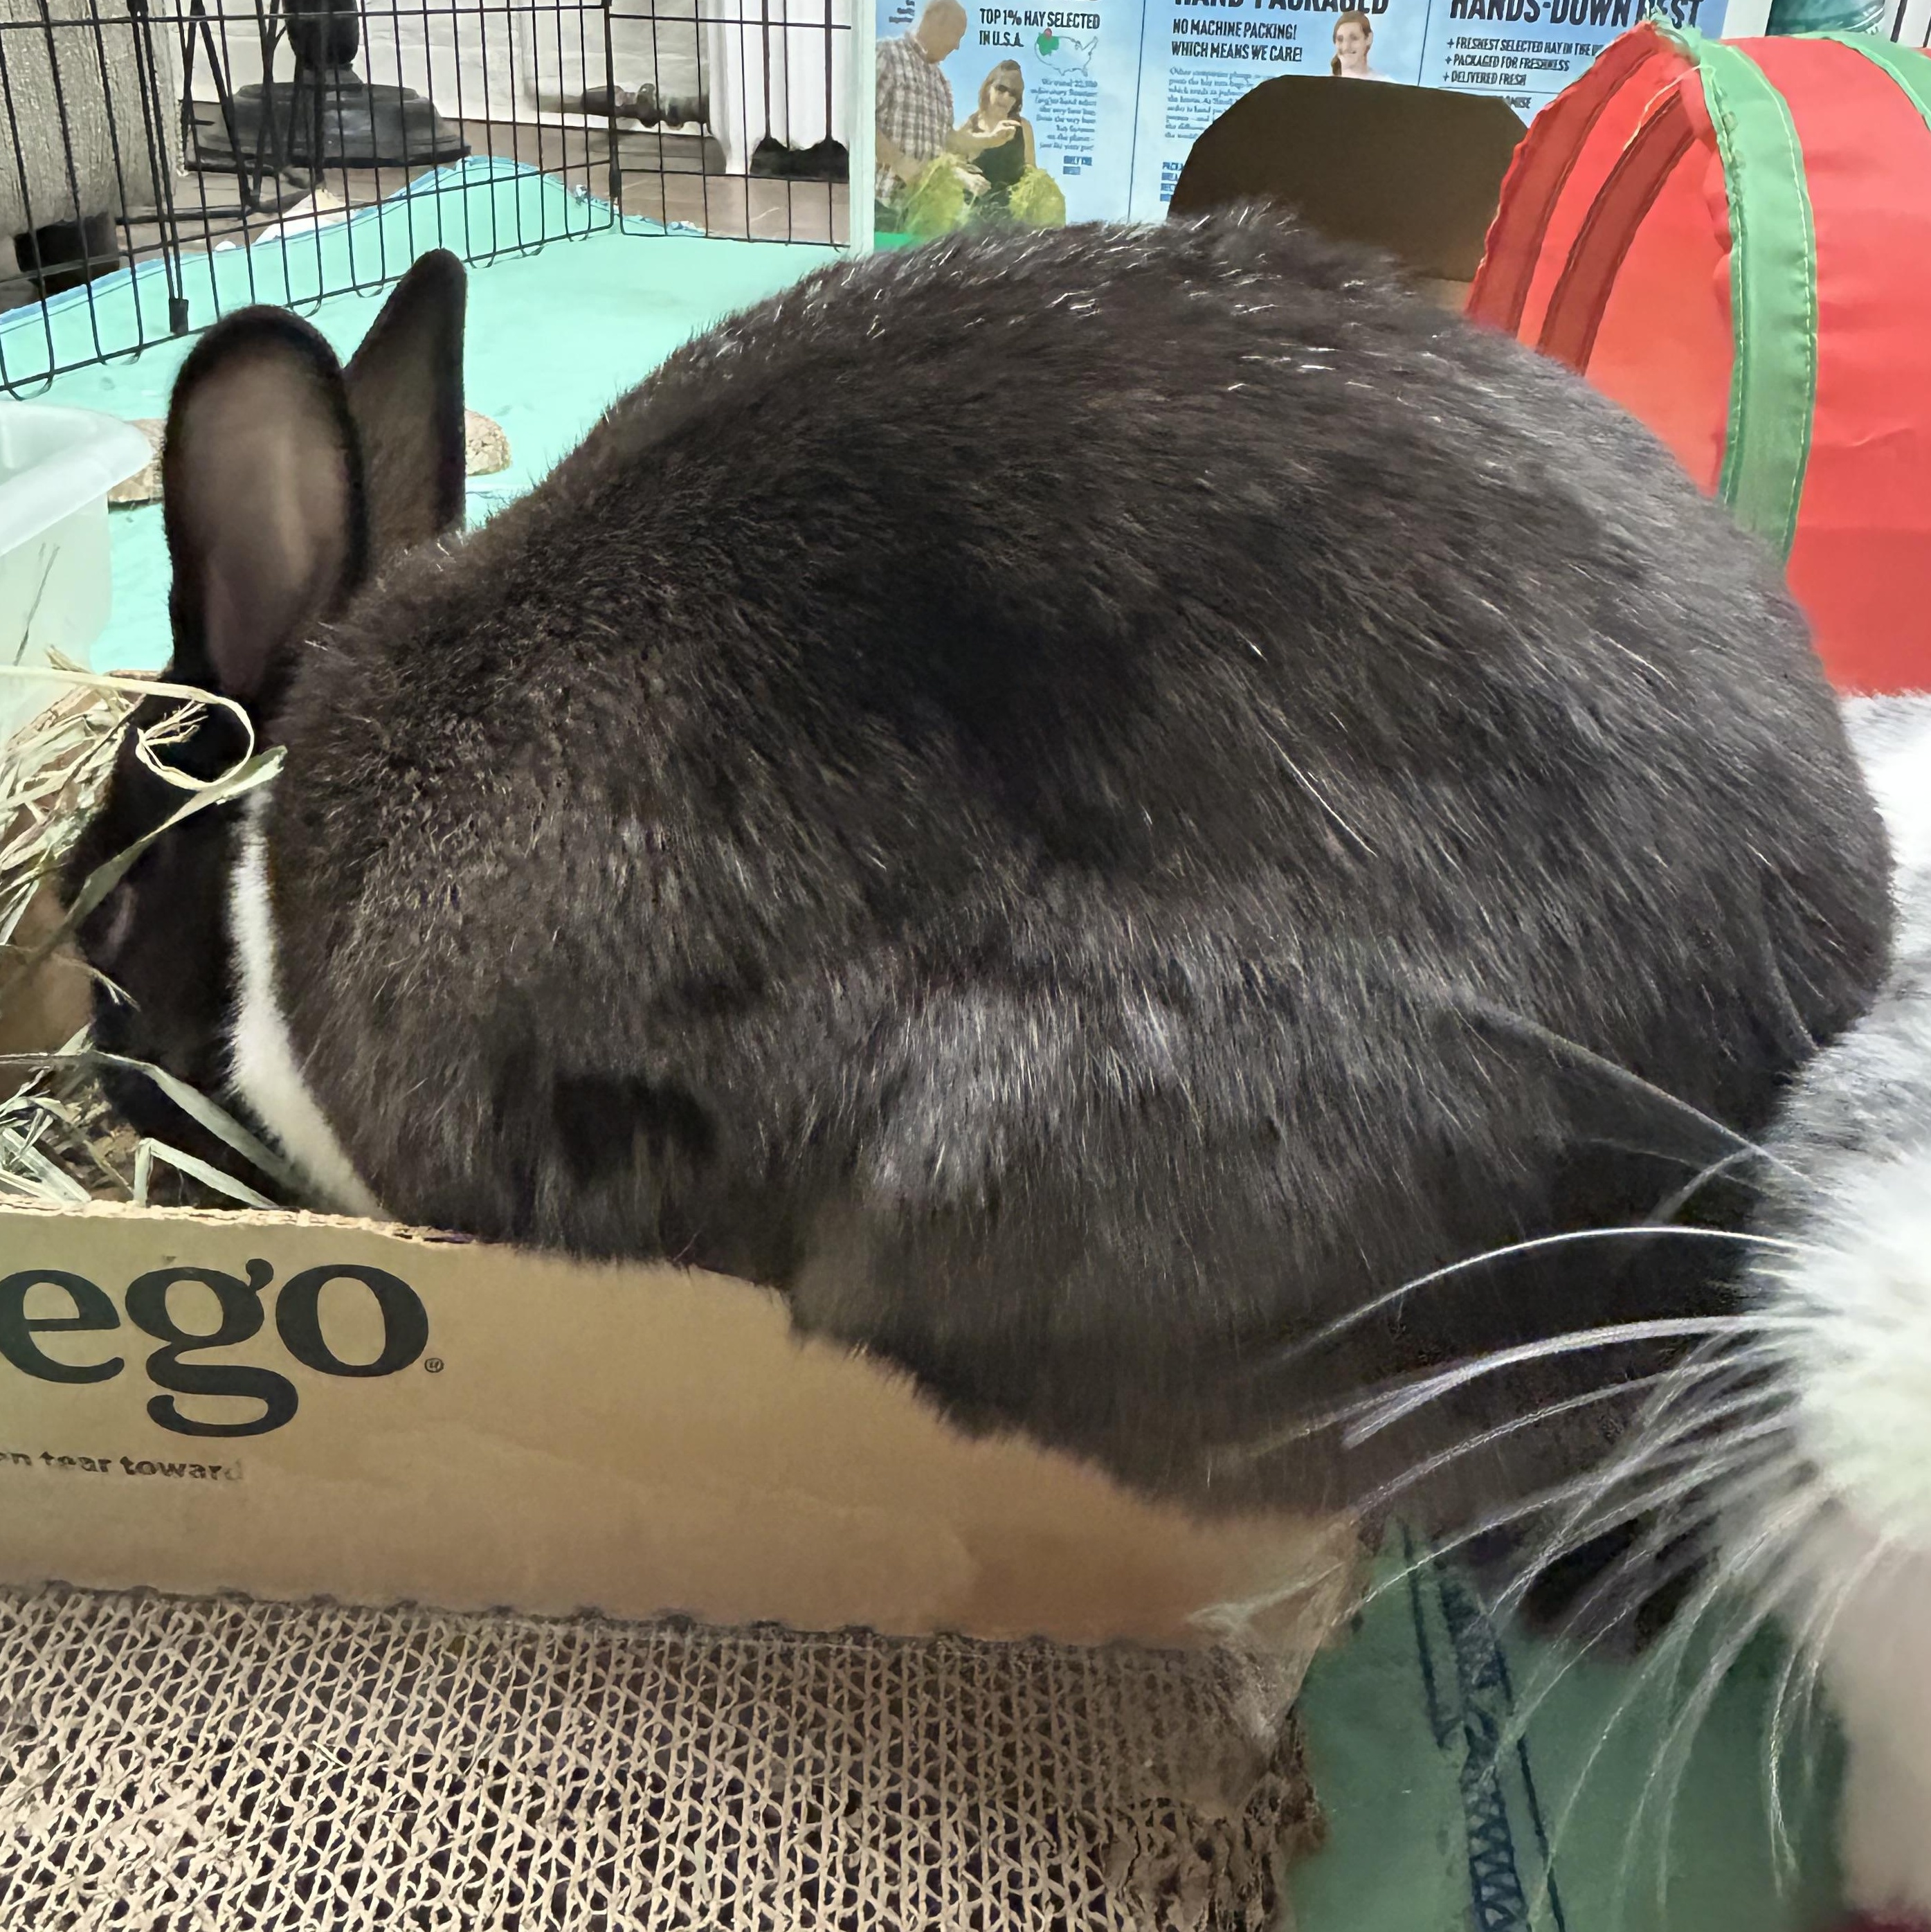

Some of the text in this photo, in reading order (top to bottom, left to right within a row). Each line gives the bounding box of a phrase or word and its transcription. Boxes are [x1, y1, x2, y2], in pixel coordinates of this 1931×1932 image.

[979, 8, 1100, 29] TOP 1% HAY SELECTED
[1450, 0, 1631, 27] HANDS-DOWN
[979, 30, 990, 45] IN
[1172, 18, 1297, 40] NO MACHINE PACKING!
[1172, 41, 1303, 62] WHICH MEANS WE CARE!
[1456, 36, 1500, 51] FRESHEST
[1500, 38, 1543, 53] SELECTED
[1544, 41, 1564, 54] HAY
[1453, 53, 1499, 68] PACKAGED
[1501, 56, 1518, 69] FOR
[1451, 71, 1526, 86] DELIVERED FRESH
[39, 1451, 112, 1473] tear
